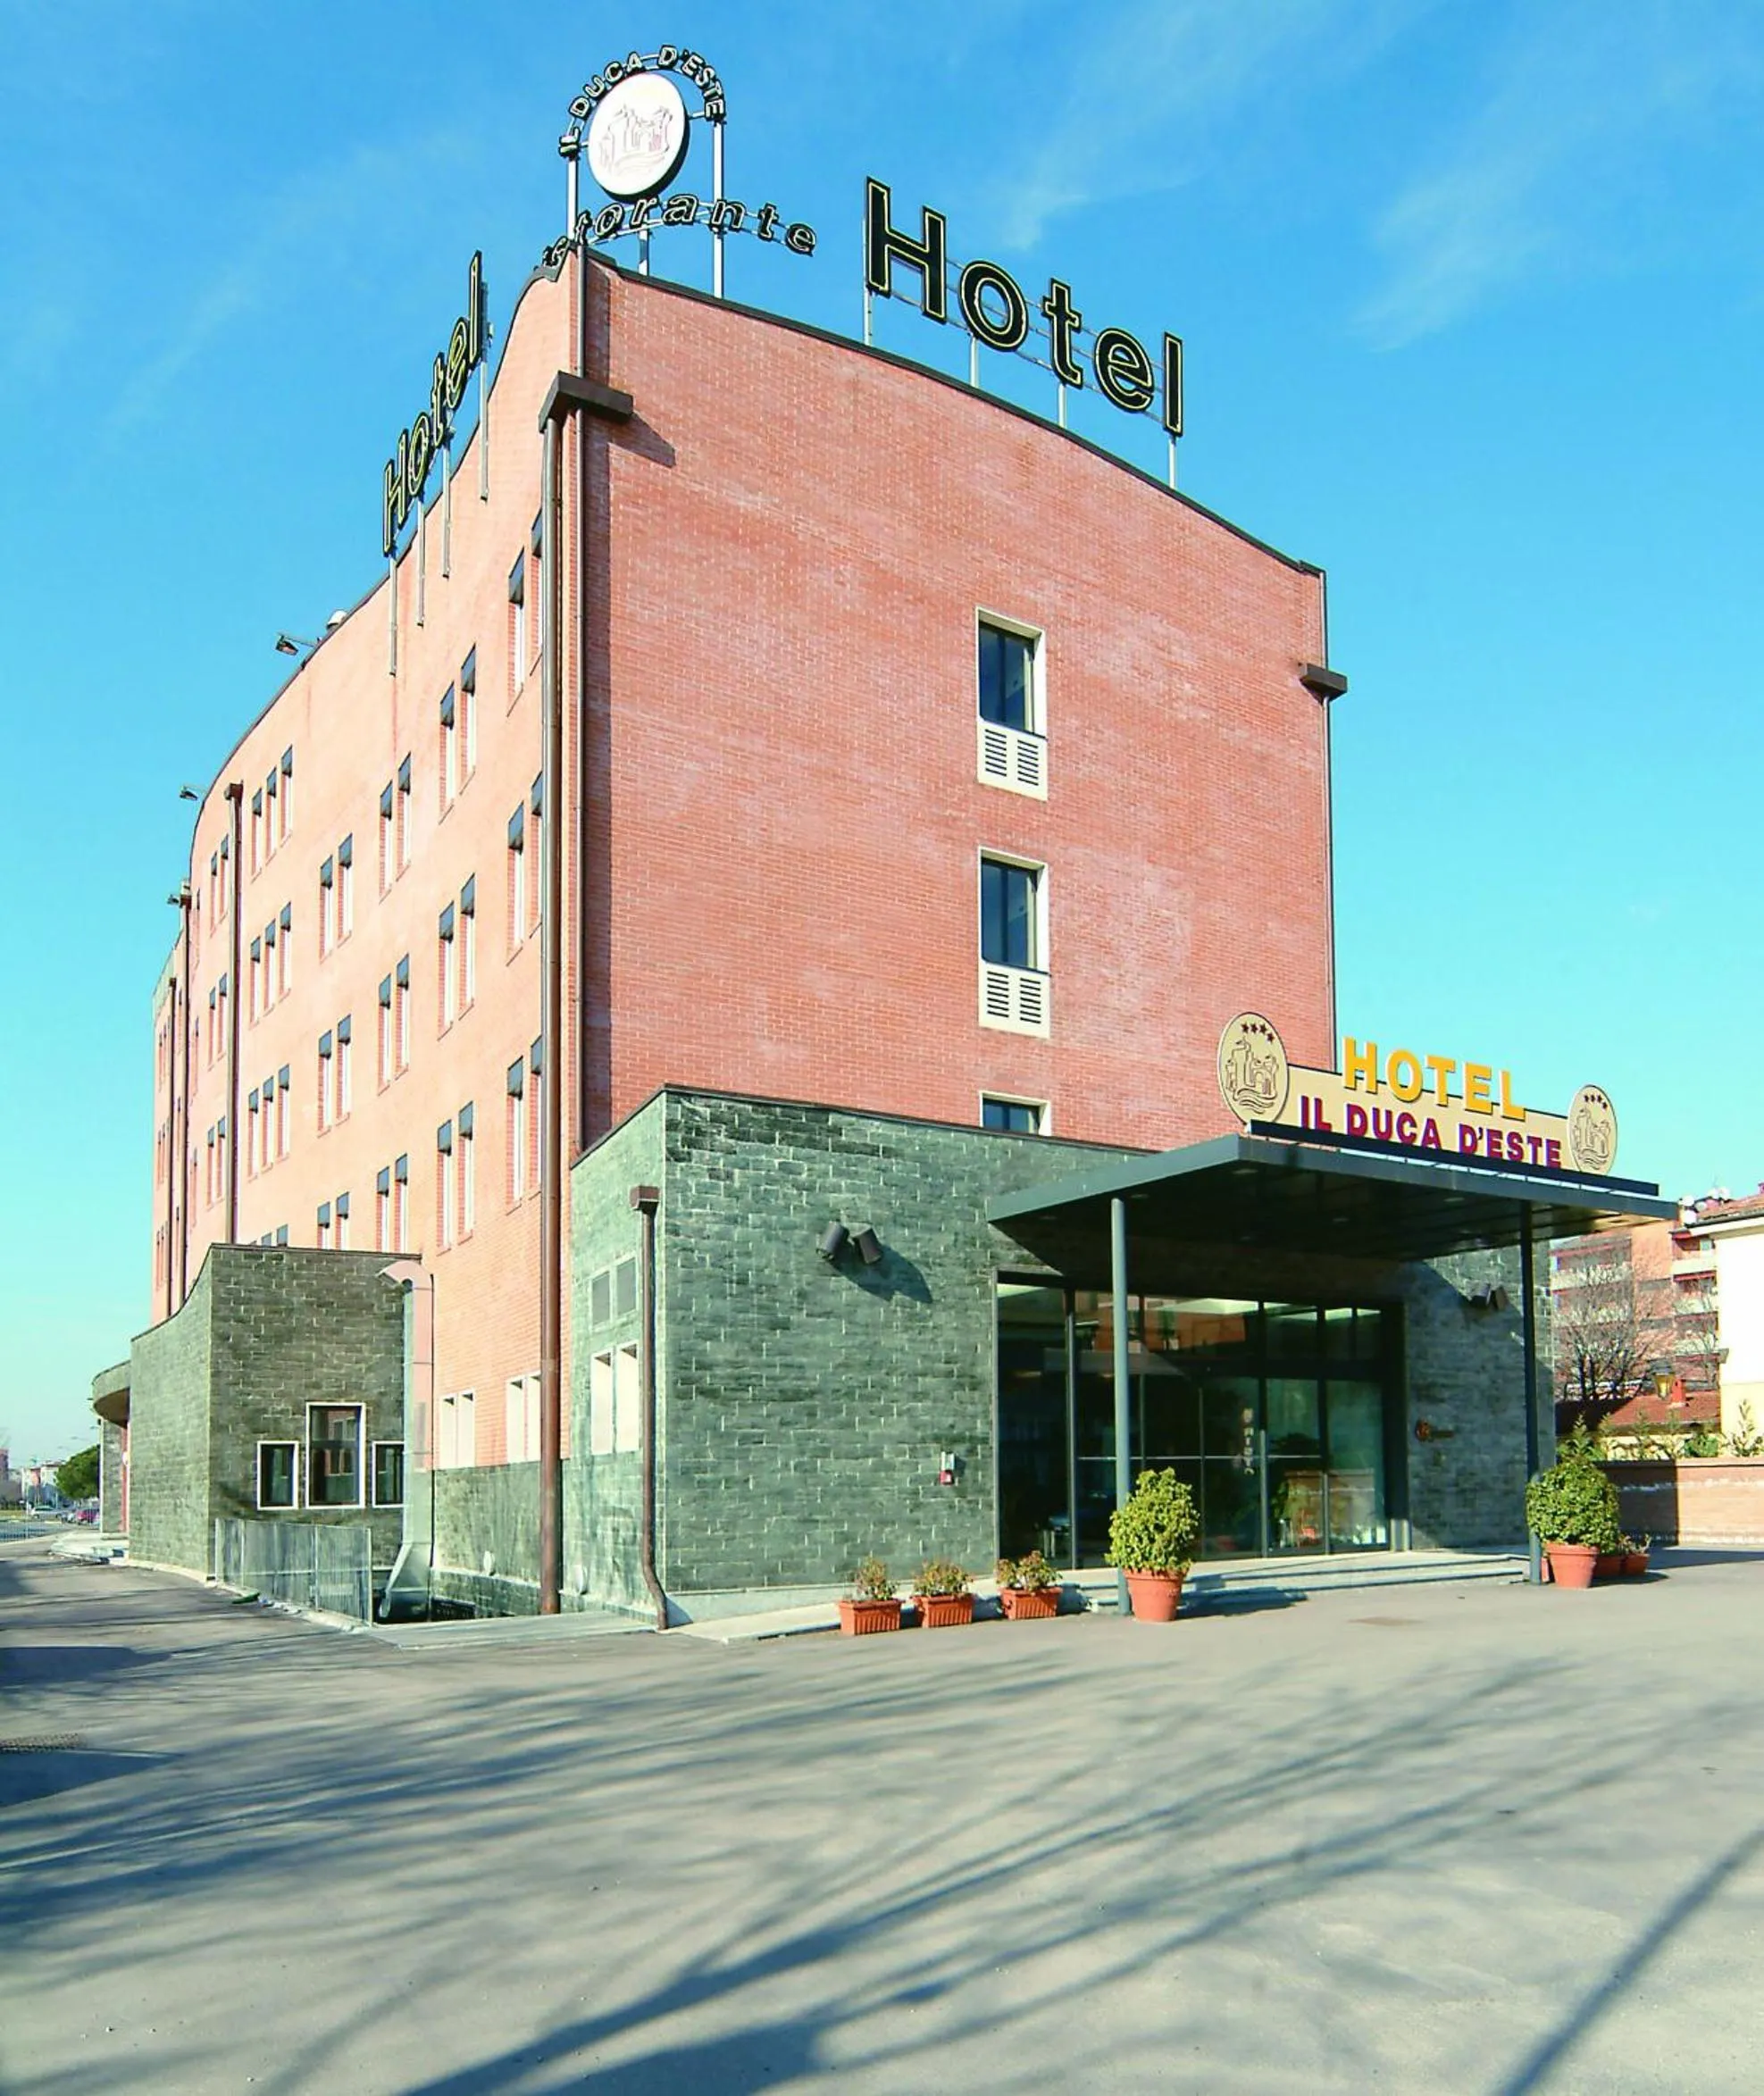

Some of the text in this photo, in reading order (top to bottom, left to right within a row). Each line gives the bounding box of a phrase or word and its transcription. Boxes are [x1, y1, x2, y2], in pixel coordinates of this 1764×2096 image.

[558, 44, 726, 158] IL DUCA D'ESTE
[534, 194, 816, 267] storante
[865, 176, 1183, 437] Hotel
[383, 249, 483, 557] Hotel
[1342, 1036, 1526, 1122] HOTEL
[1300, 1095, 1562, 1169] IL DUCA D'ESTE
